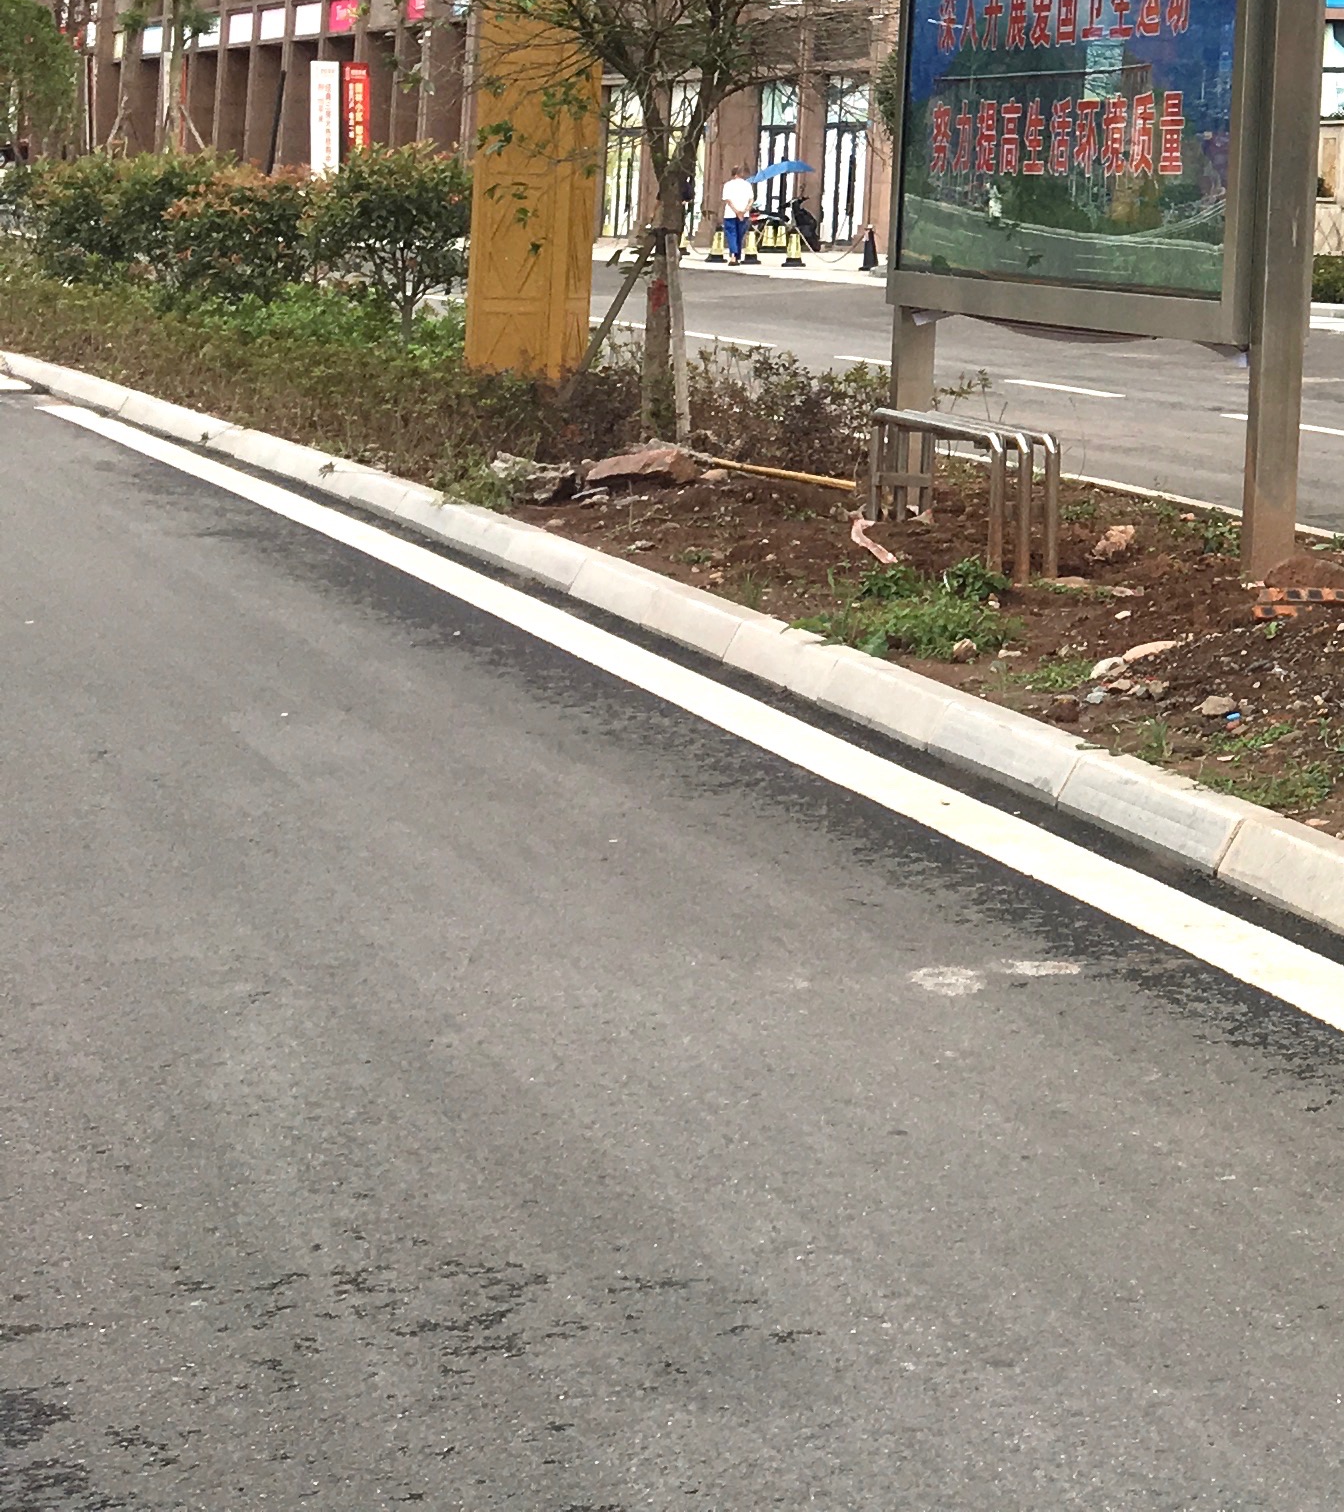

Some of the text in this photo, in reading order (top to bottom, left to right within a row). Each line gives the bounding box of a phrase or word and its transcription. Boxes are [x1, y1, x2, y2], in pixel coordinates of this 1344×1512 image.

[930, 90, 1185, 177] 努力提高生活环境质量
